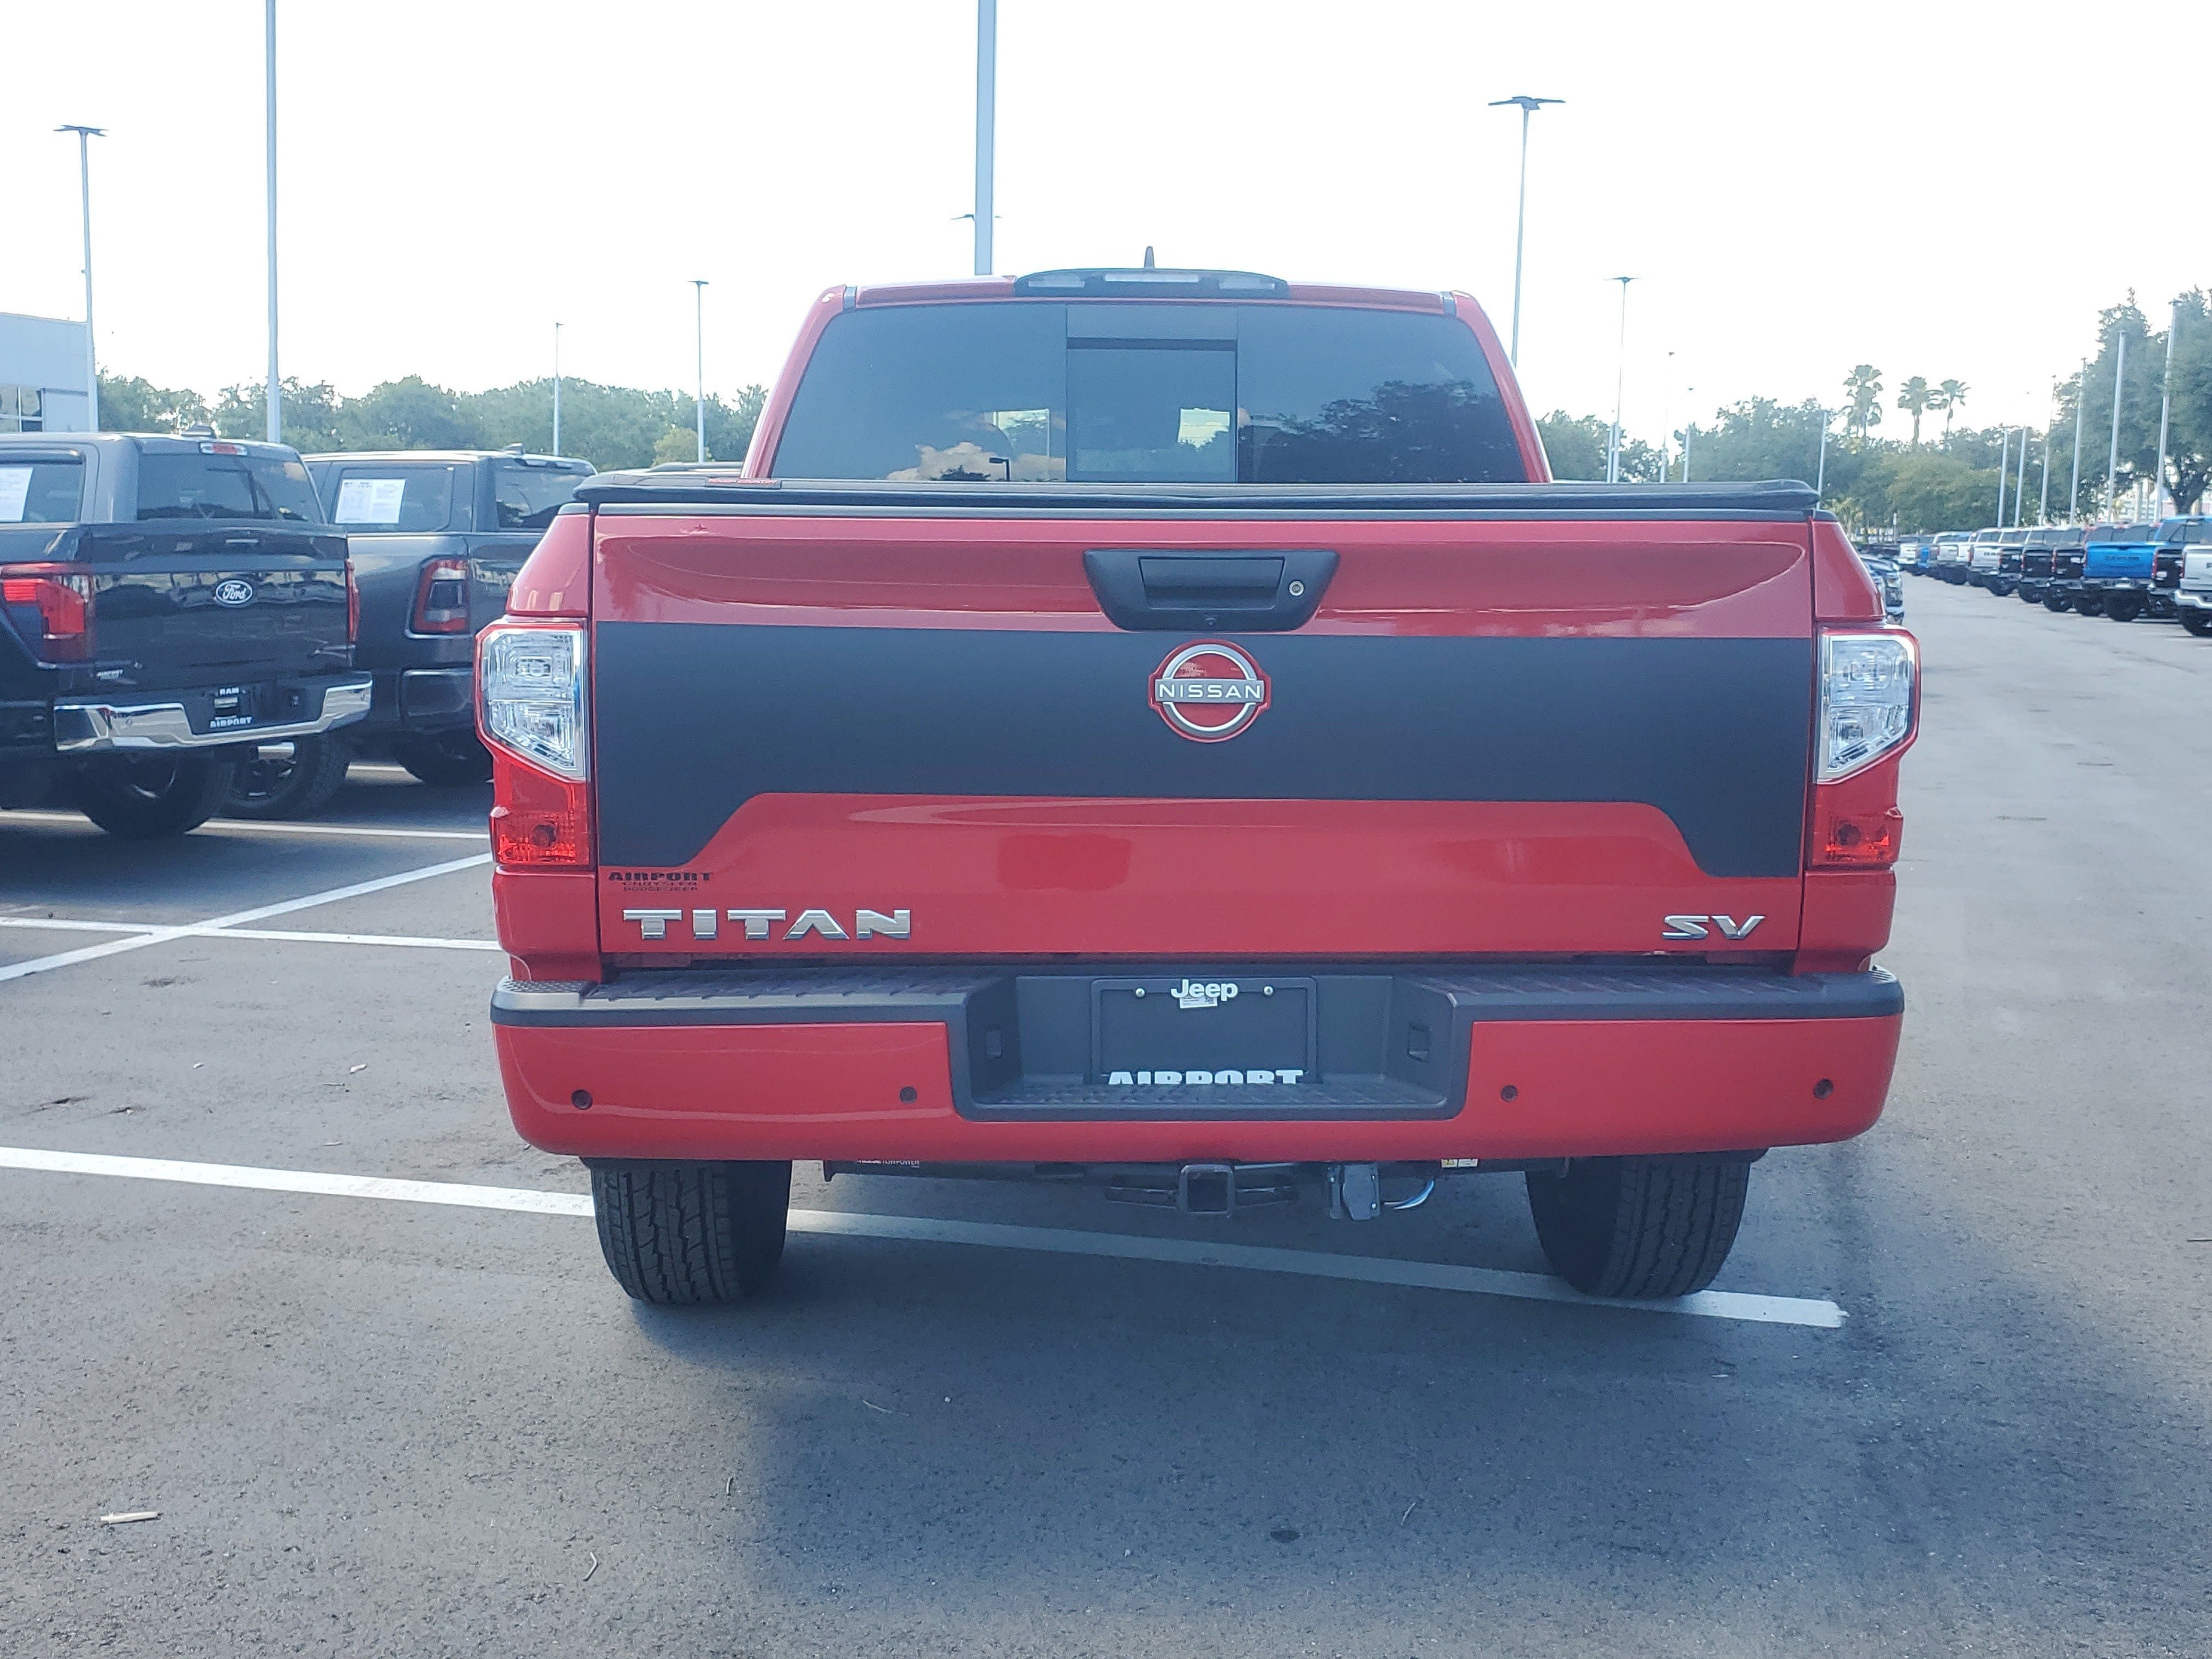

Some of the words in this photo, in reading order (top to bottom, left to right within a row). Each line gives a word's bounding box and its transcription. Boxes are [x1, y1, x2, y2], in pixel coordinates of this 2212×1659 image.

[222, 584, 246, 600] Ford
[1159, 684, 1261, 698] NISSAN
[210, 718, 252, 729] AIRPORT
[608, 872, 710, 881] AIRPORT
[623, 909, 911, 940] TITAN
[1662, 915, 1765, 940] SV
[1171, 979, 1238, 1001] Jeep
[1108, 1070, 1304, 1085] AIRPORT
